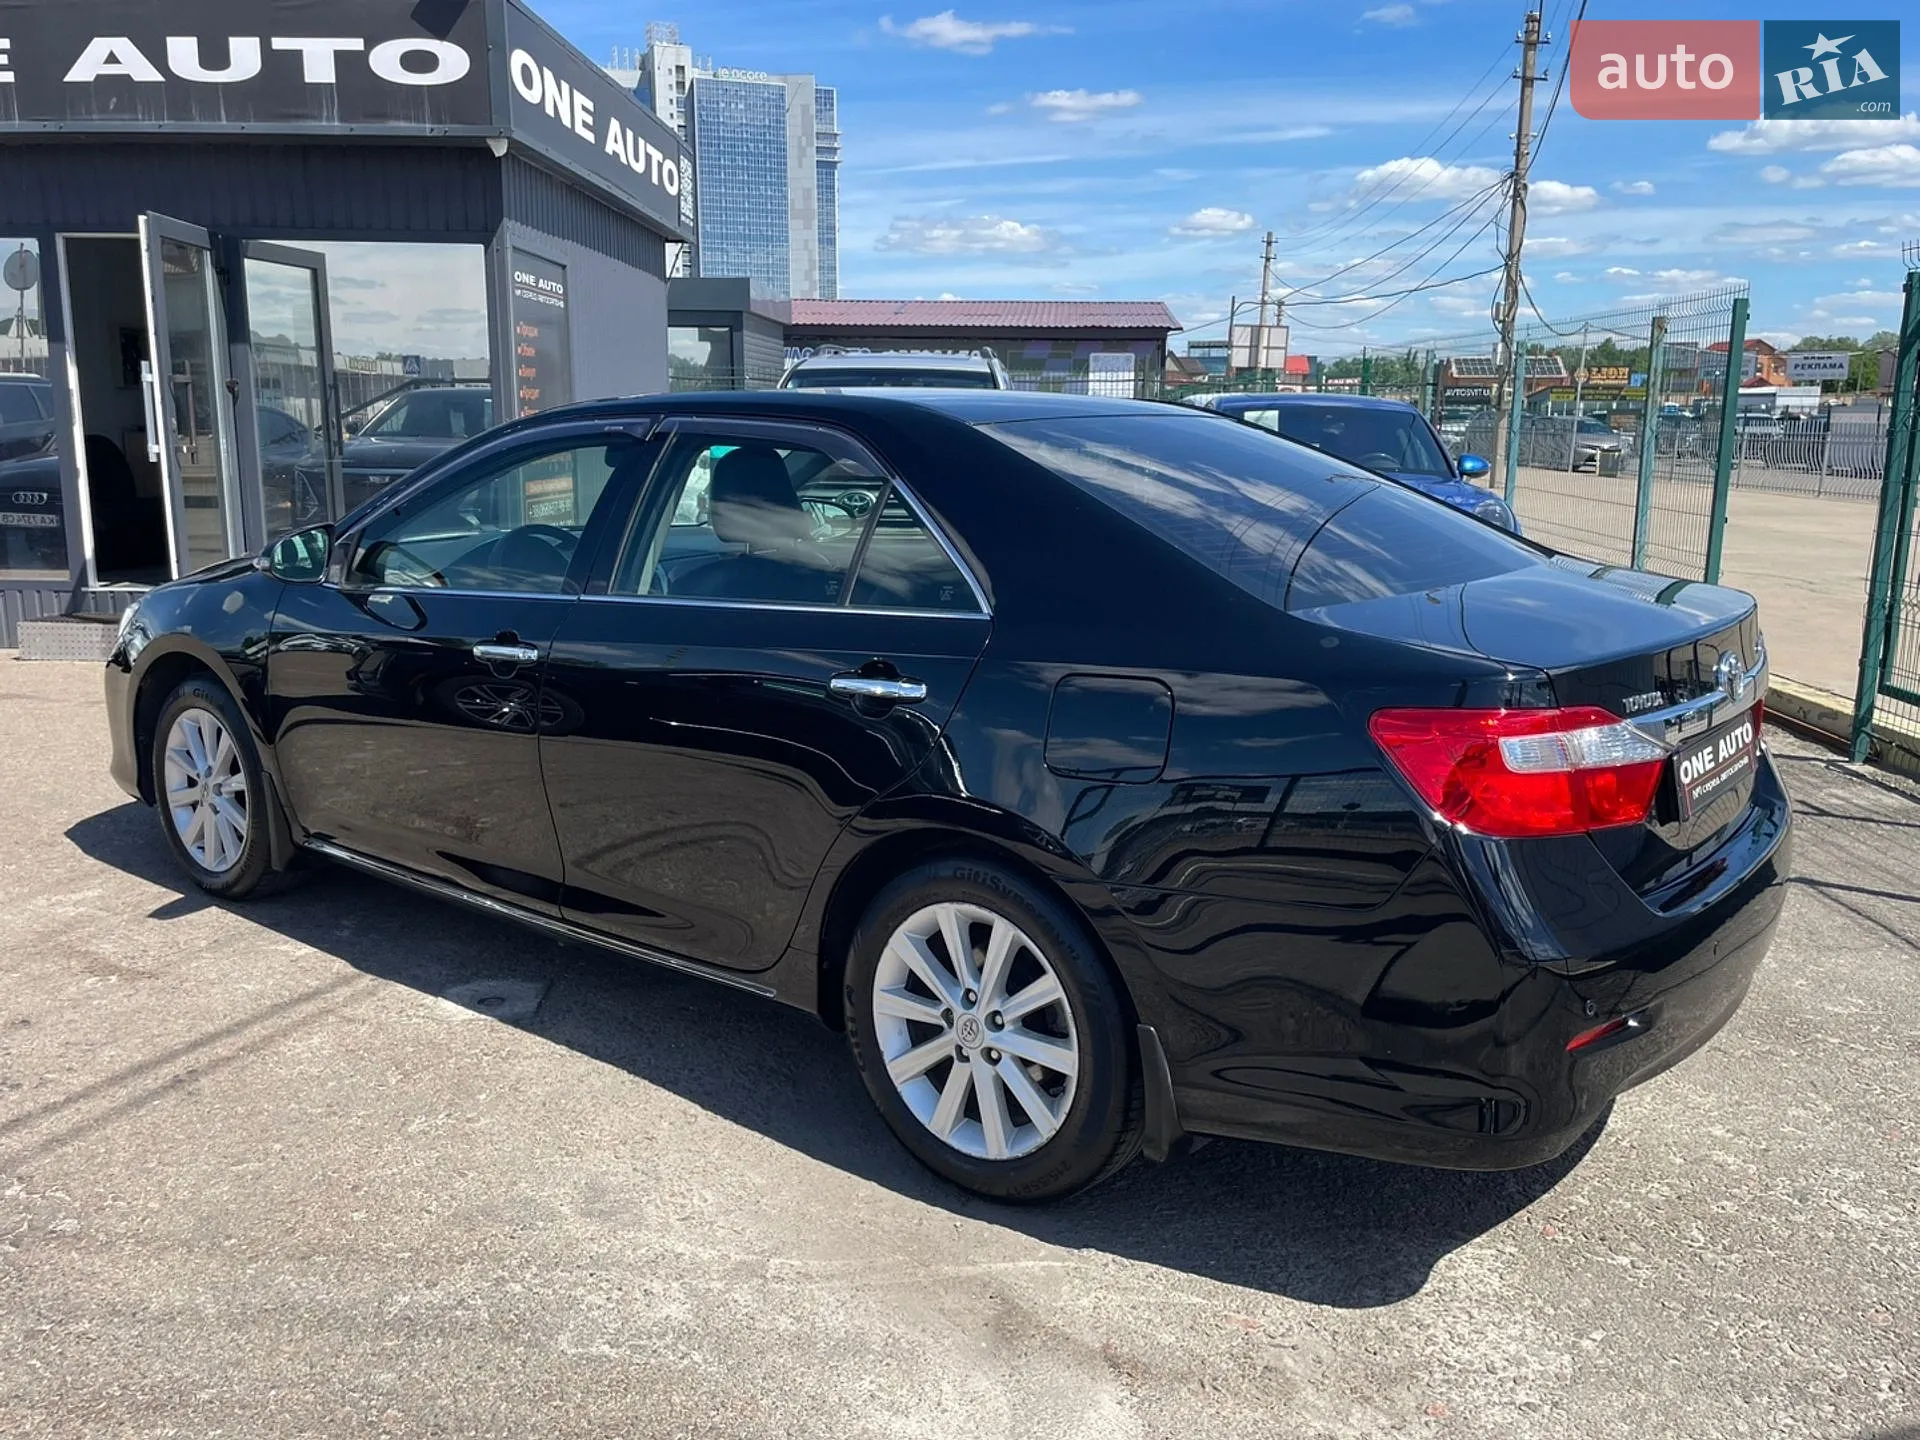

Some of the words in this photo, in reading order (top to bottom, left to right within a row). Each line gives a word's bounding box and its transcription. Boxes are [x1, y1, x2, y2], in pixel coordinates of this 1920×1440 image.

[63, 36, 470, 85] AUTO
[510, 47, 595, 144] ONE
[604, 116, 680, 197] AUTO
[514, 271, 536, 286] ONE
[538, 278, 564, 294] AUTO
[1793, 362, 1845, 370] РЕКЛАМА
[1622, 691, 1664, 713] TOYOTA
[1680, 746, 1715, 784] ONE
[1719, 722, 1753, 762] AUTO
